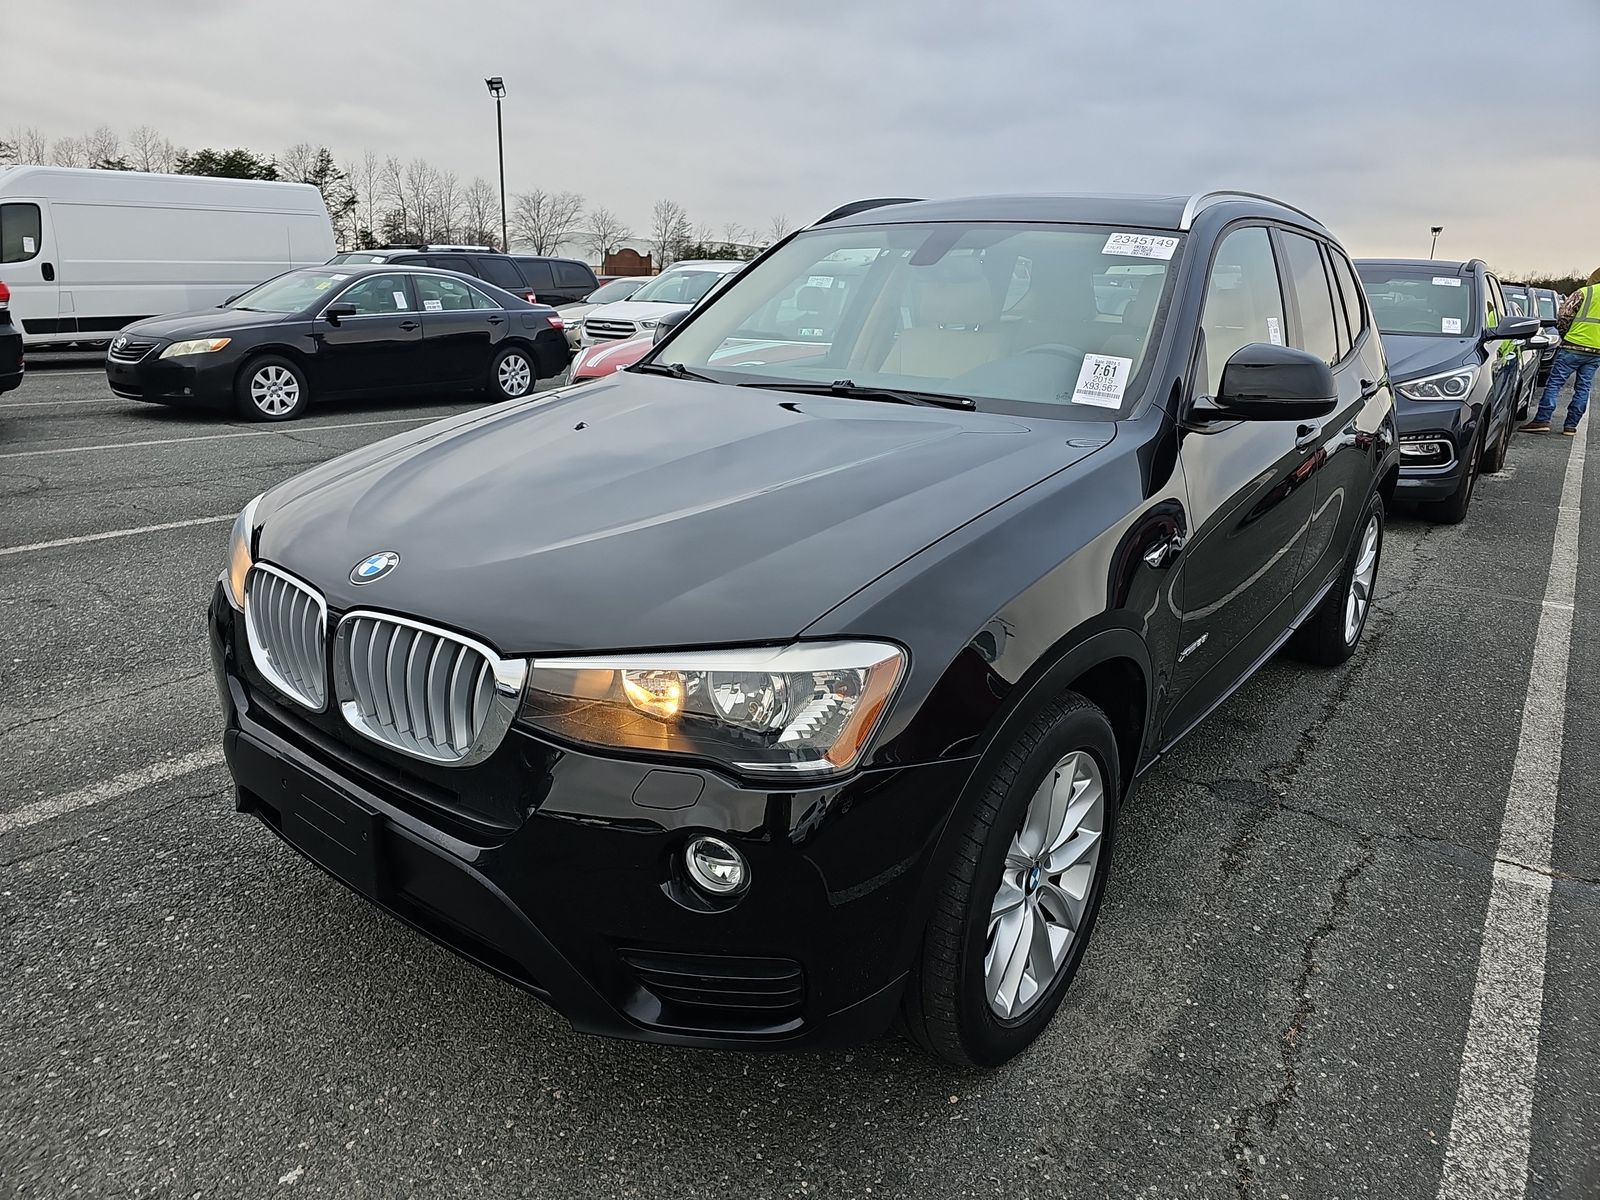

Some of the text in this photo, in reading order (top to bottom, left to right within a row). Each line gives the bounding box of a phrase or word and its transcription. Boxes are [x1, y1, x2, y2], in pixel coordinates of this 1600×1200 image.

[1113, 235, 1174, 248] 2345149
[1093, 363, 1117, 378] 7:61
[1092, 375, 1114, 384] 2015
